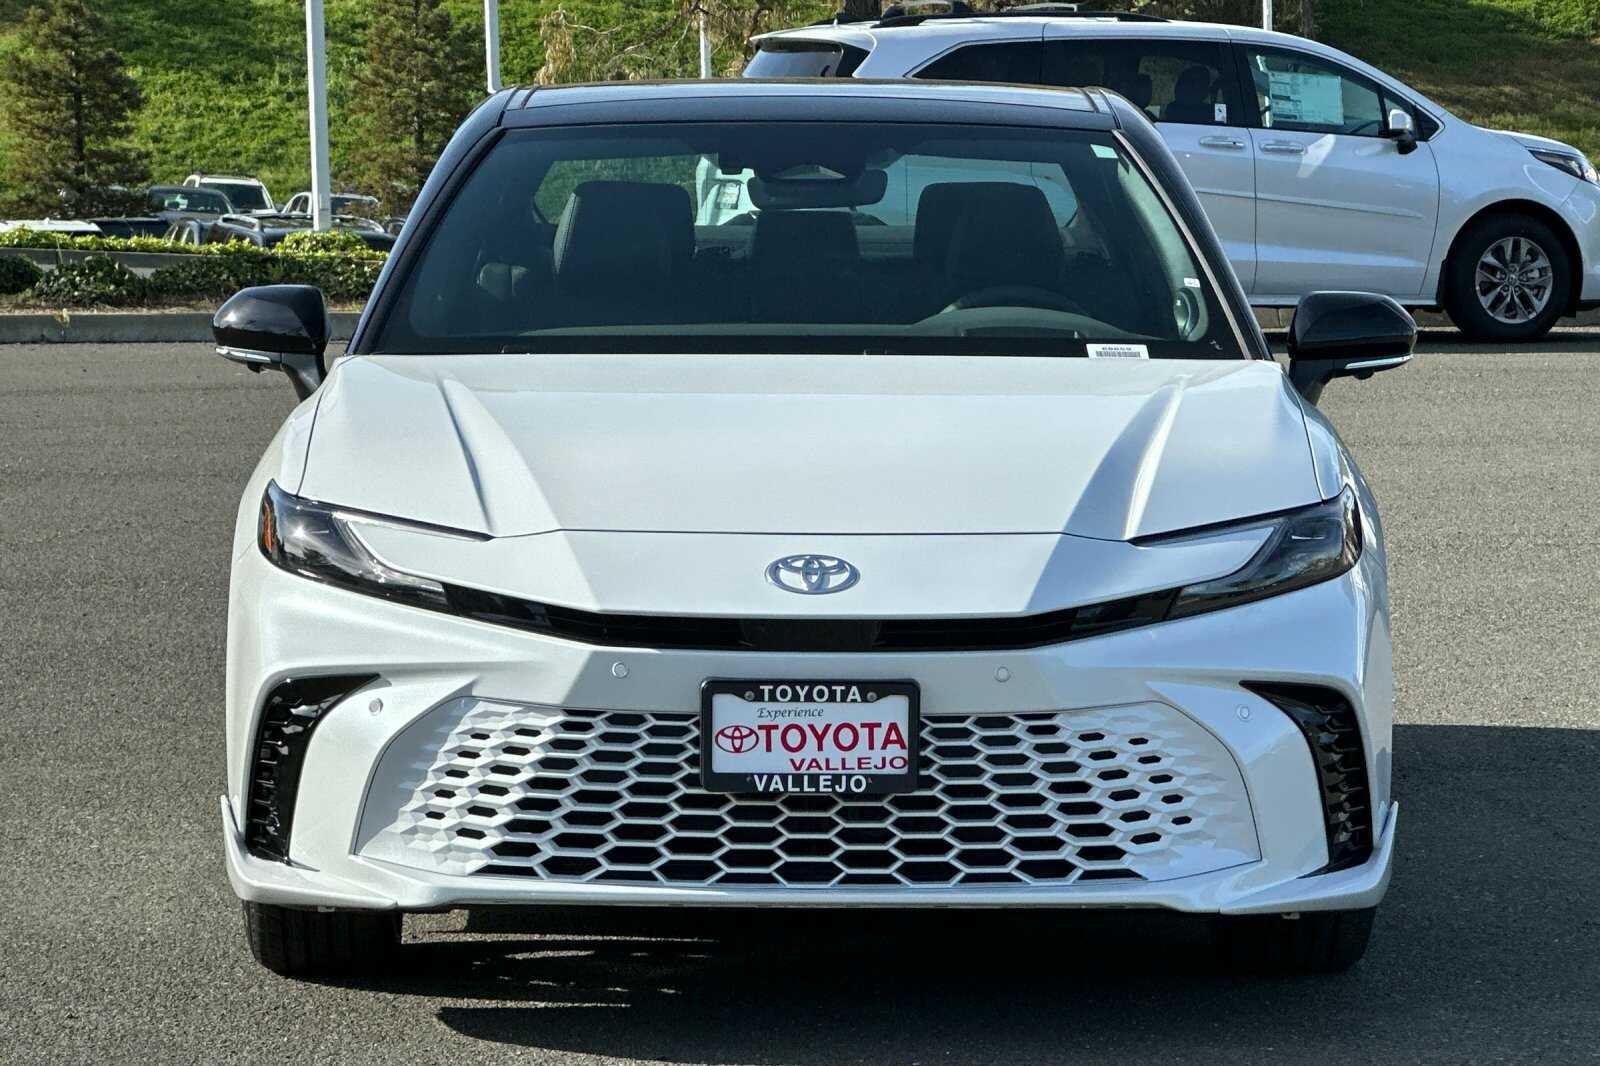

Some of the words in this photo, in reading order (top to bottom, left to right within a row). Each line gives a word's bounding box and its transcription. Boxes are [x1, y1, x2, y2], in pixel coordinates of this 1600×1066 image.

[759, 685, 862, 702] TOYOTA
[757, 707, 824, 721] Experience
[757, 722, 907, 753] TOYOTA
[789, 756, 908, 771] VALLEJO
[753, 774, 867, 792] VALLEJO
